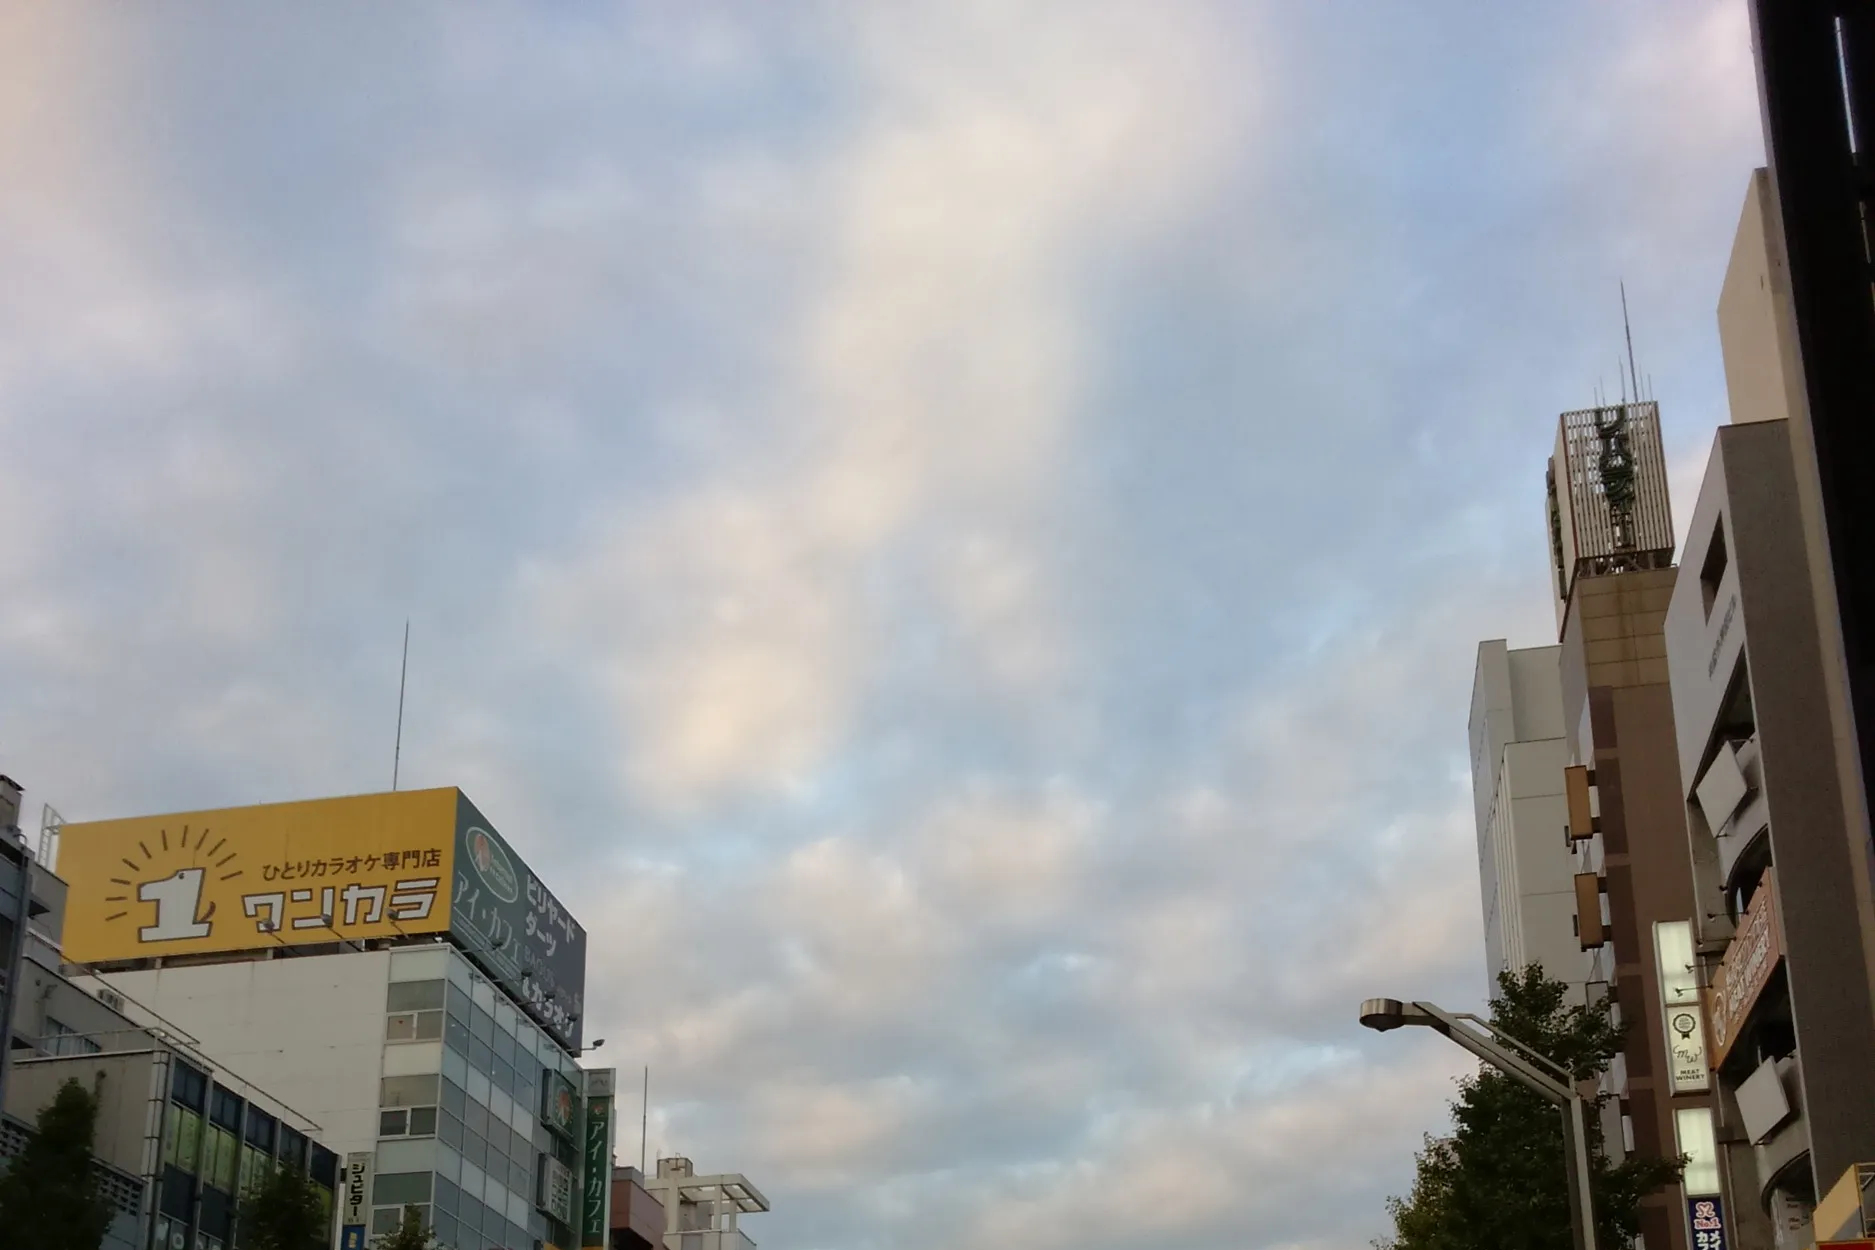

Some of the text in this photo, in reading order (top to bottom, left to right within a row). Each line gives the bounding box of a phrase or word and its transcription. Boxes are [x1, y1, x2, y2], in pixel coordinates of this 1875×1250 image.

[262, 848, 442, 883] ひとりカラオケ専門店
[242, 877, 441, 935] ワンカラ
[525, 910, 557, 957] ダーツ
[526, 874, 576, 944] ビリヤード
[585, 1119, 604, 1245] アイ・カフェ
